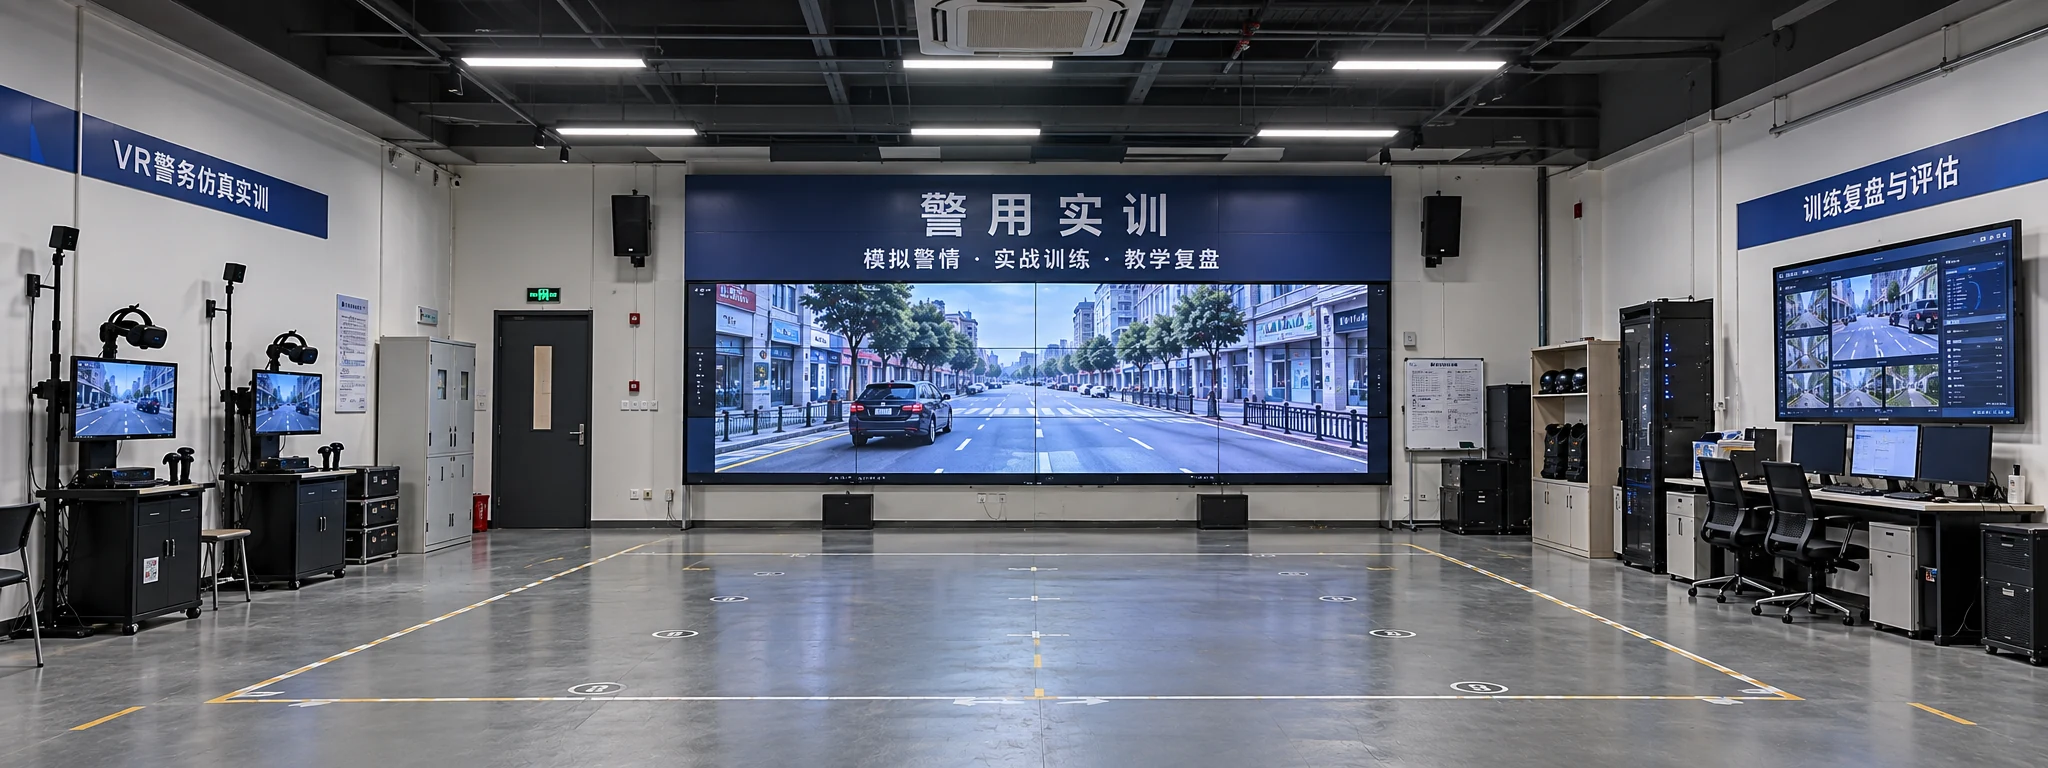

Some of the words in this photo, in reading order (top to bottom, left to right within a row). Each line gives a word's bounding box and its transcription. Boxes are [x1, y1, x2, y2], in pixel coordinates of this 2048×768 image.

[113, 139, 269, 212] VR警务仿真实训
[1803, 154, 1959, 222] 训练复盘与评估
[920, 192, 1167, 237] 警用实训
[863, 248, 961, 270] 模拟警情
[994, 248, 1090, 270] 实战训练
[1124, 248, 1220, 270] 教学复盘
